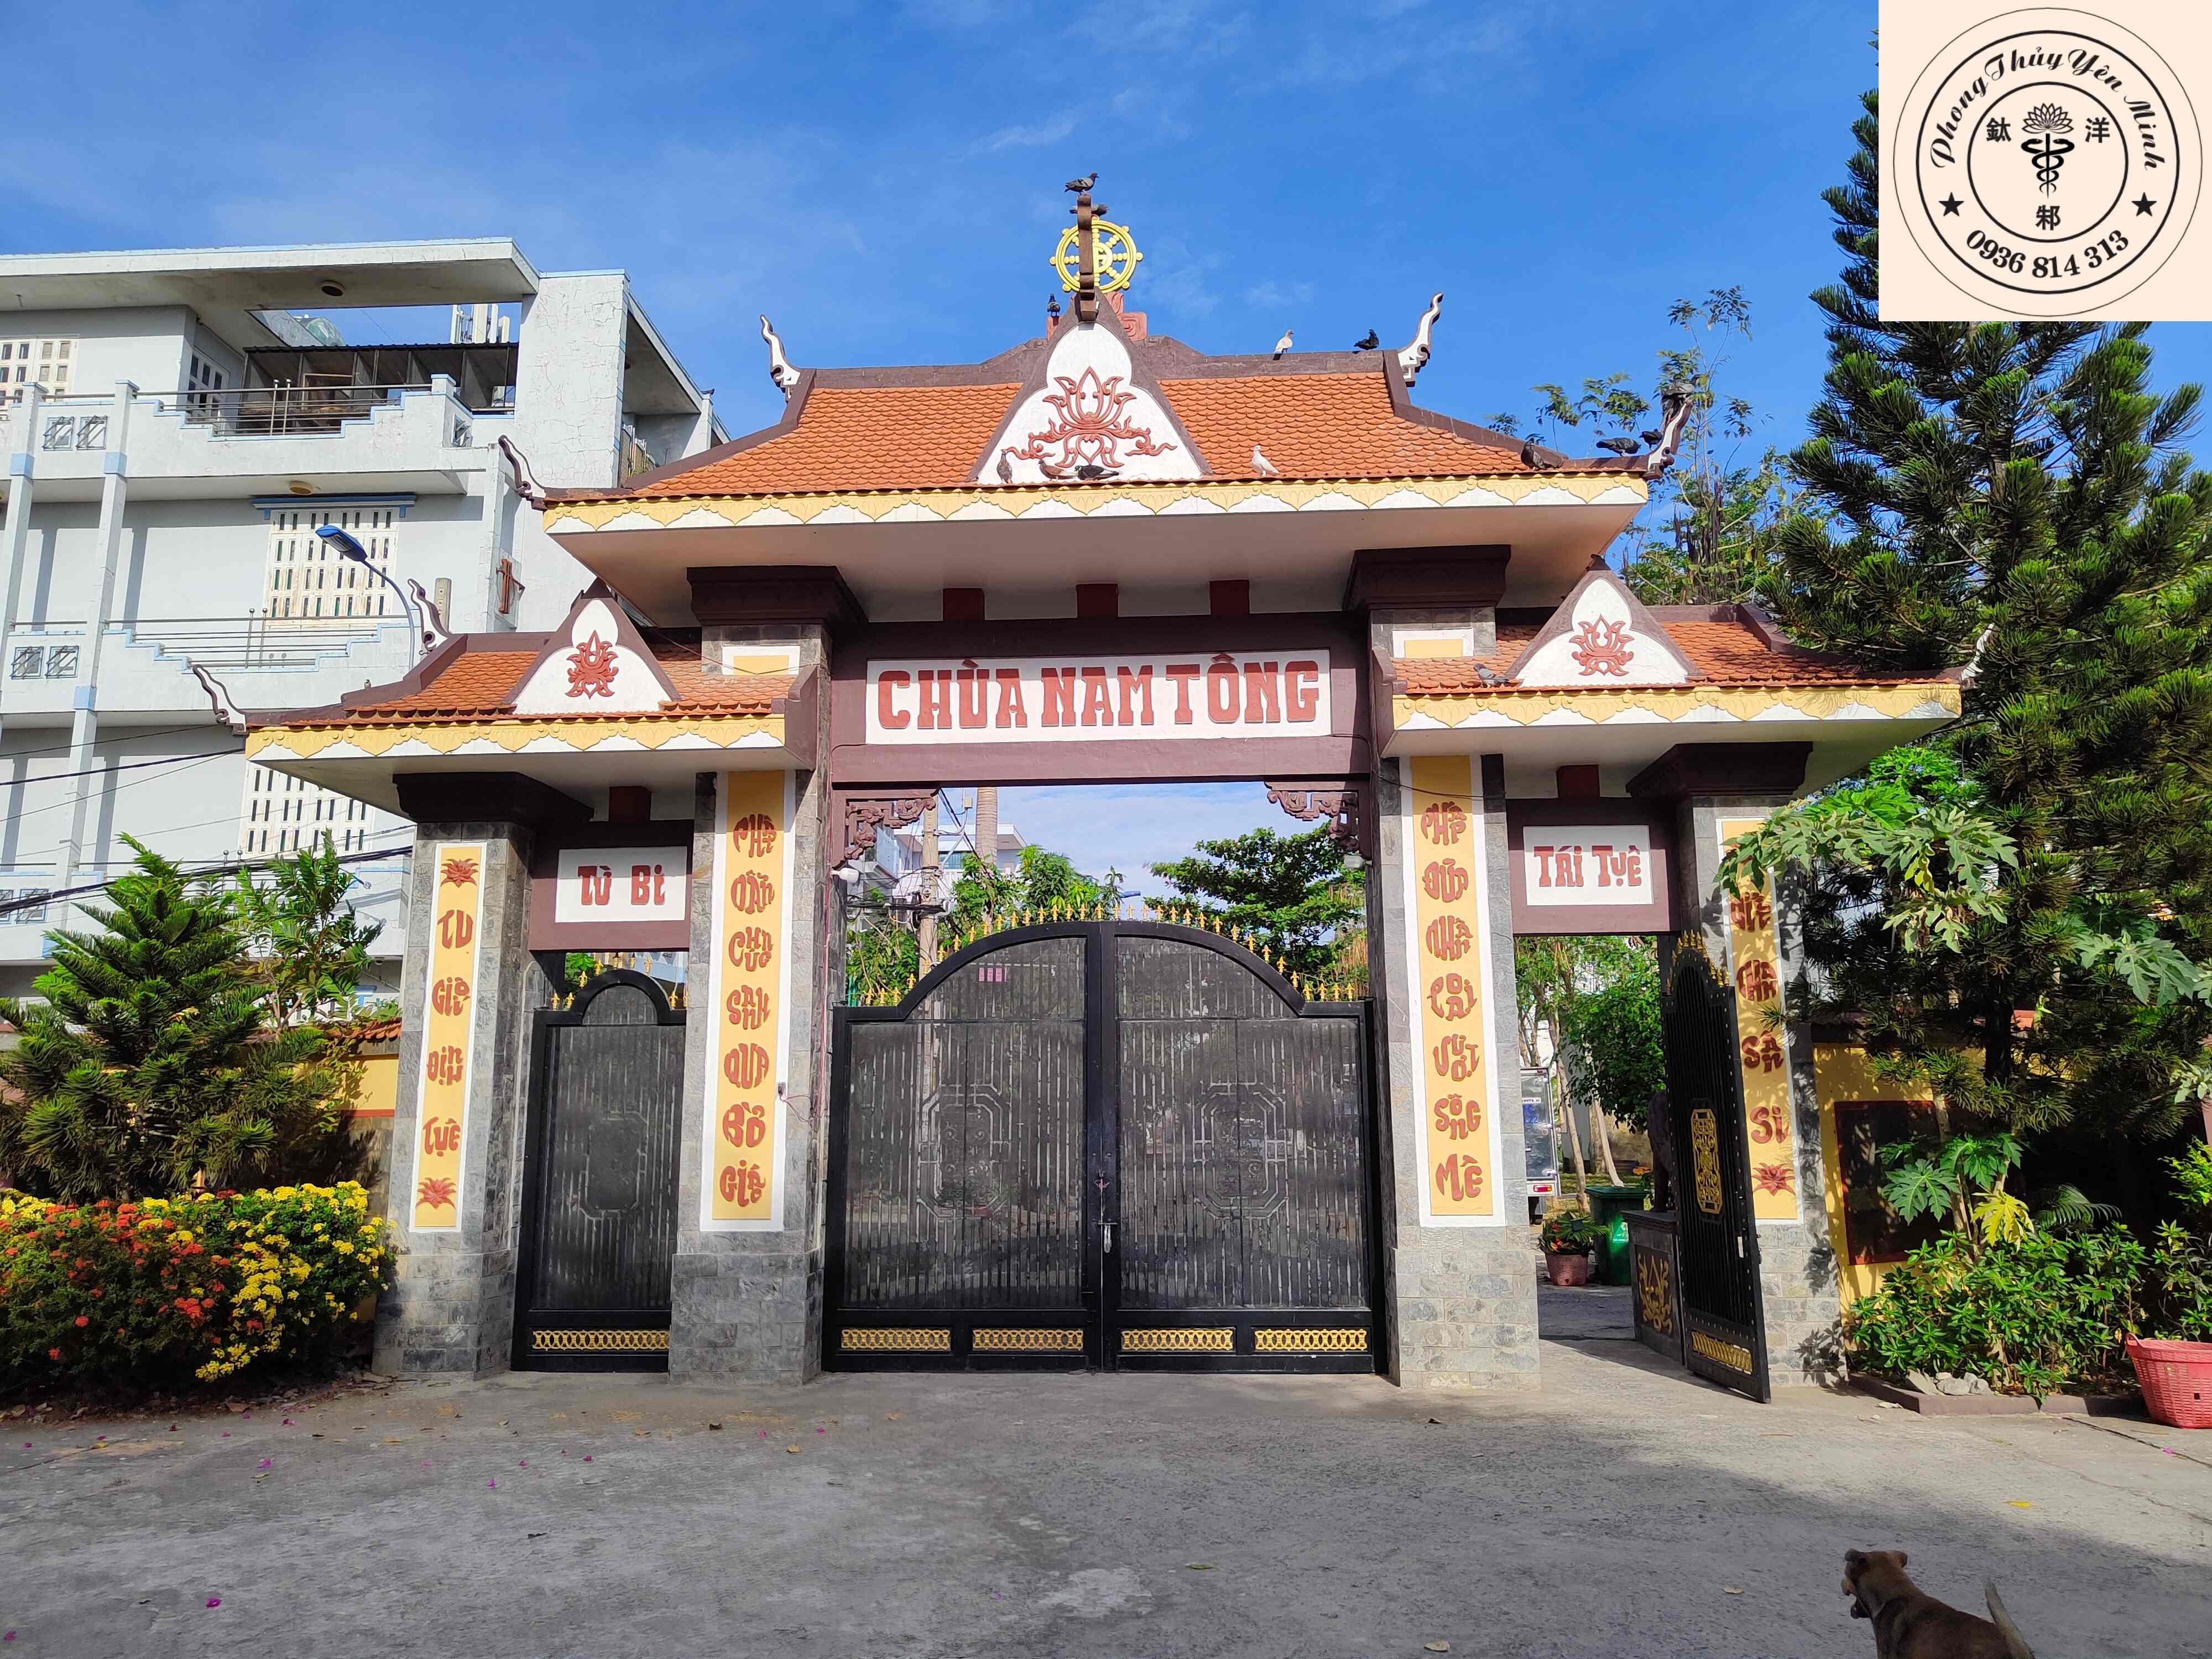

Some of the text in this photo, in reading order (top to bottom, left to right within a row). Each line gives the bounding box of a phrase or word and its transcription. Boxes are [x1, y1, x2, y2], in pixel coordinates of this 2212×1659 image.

[878, 653, 1319, 730] CHÙA NAM TÔNG
[630, 864, 666, 905] BI
[1533, 845, 1642, 887] TRÍ TUỆ
[724, 1043, 769, 1089] QUA
